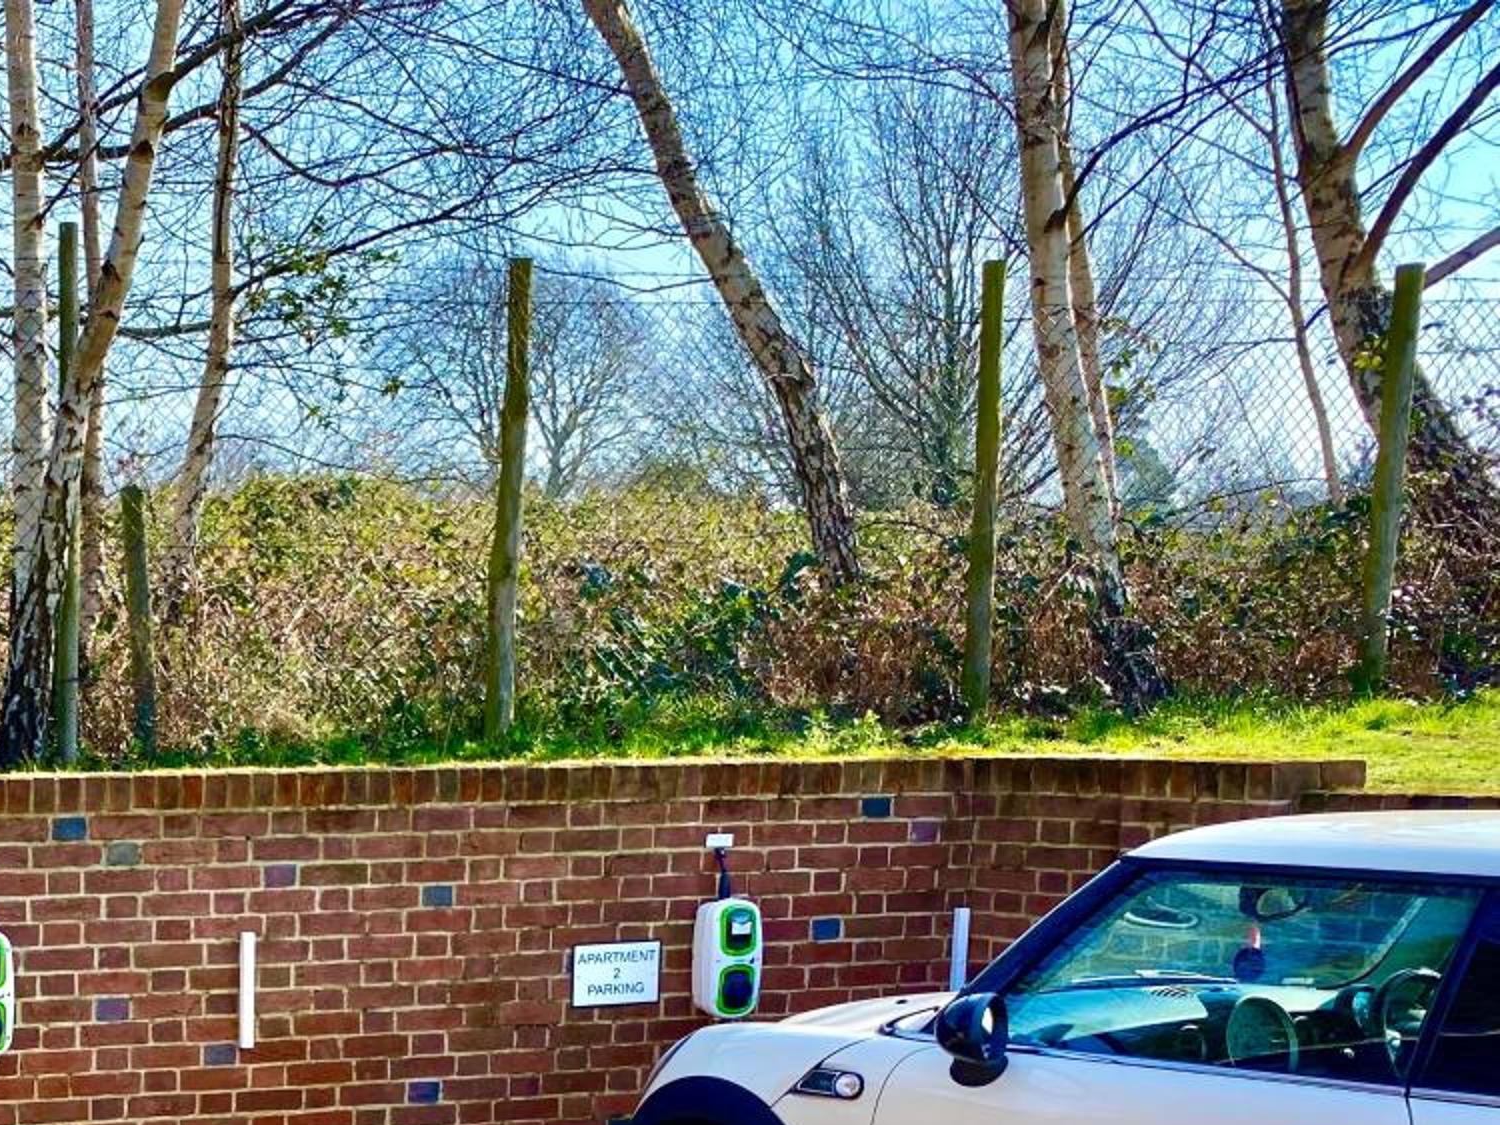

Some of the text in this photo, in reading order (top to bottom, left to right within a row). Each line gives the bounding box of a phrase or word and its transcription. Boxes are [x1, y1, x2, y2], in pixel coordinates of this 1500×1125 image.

[577, 950, 656, 965] APARTMENT
[613, 967, 621, 979] 2
[587, 981, 645, 996] PARKING
